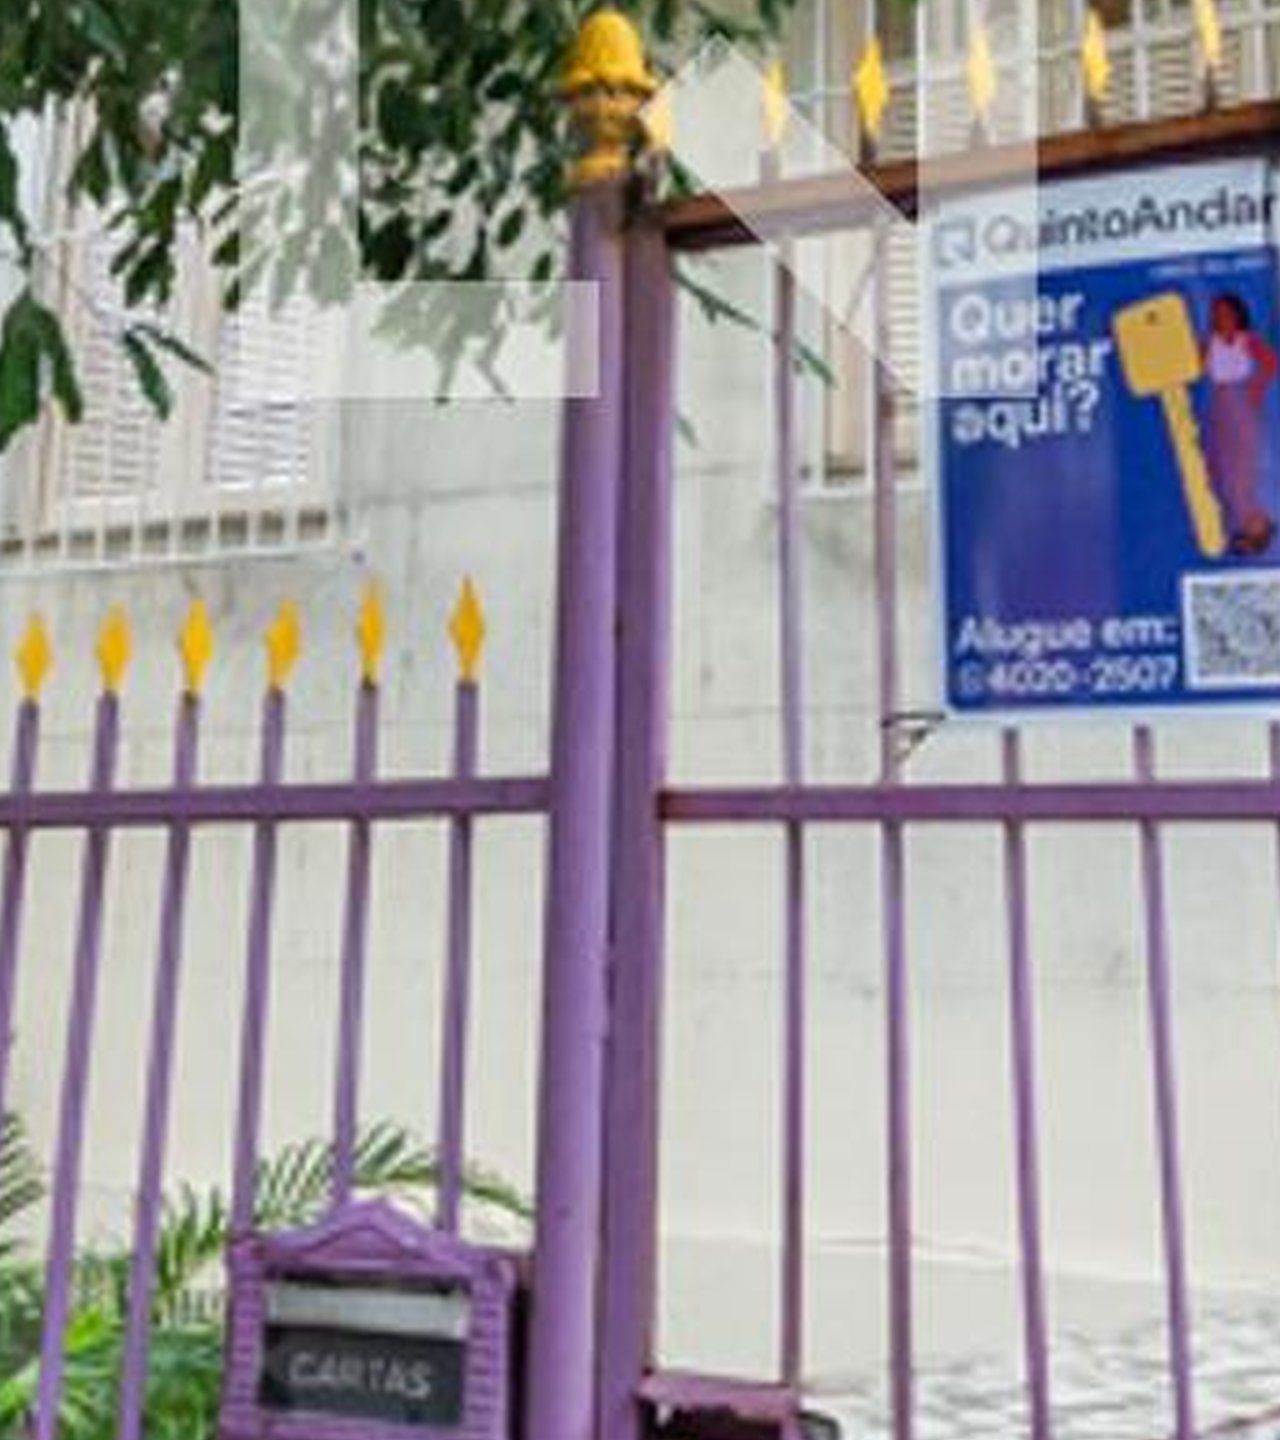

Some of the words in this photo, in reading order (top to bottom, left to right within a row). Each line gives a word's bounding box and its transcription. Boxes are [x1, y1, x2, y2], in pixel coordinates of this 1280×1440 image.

[982, 186, 1277, 258] QuintoAndar
[950, 292, 1085, 342] Quer
[951, 338, 1112, 391] morar
[951, 380, 1100, 449] aqui?
[954, 616, 1092, 660] Alugue
[1100, 617, 1179, 650] em:
[287, 1349, 432, 1401] CARTAS
